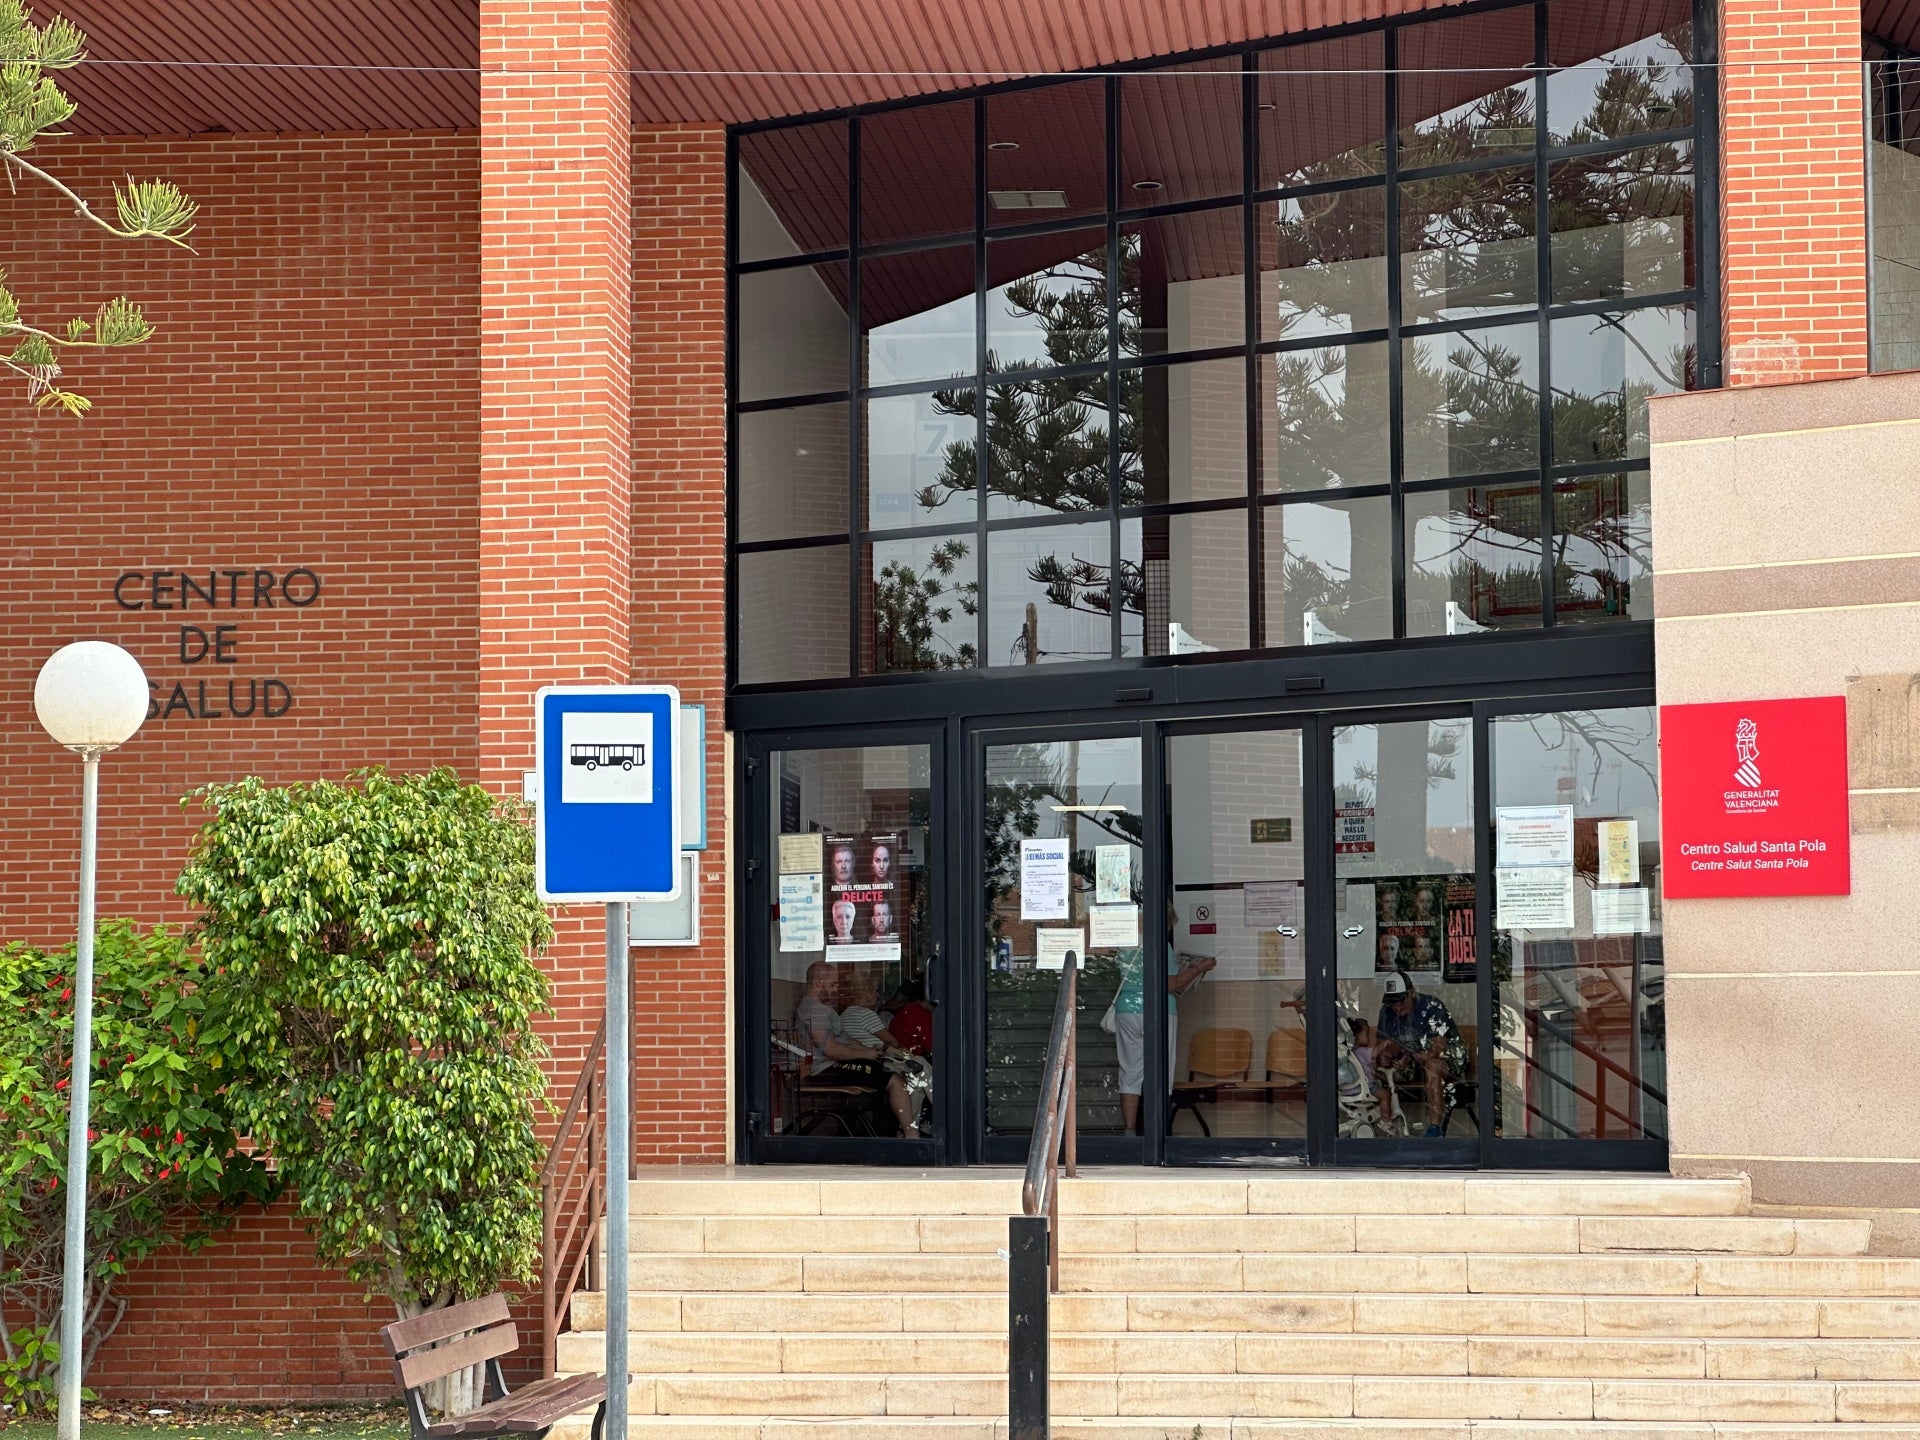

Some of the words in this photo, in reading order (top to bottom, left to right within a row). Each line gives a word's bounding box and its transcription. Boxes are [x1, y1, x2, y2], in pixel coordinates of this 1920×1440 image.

[923, 424, 949, 455] 7
[114, 568, 320, 610] CENTRO
[180, 625, 237, 664] DE
[1724, 790, 1780, 800] GENERALITAT
[1725, 799, 1779, 809] VALENCIANA
[1342, 834, 1367, 842] NECESITE
[1680, 843, 1721, 856] Centro
[1723, 841, 1757, 854] Salud
[1760, 840, 1796, 853] Santa
[1799, 839, 1827, 852] Pola
[1046, 852, 1064, 860] SOCIAL
[1691, 860, 1724, 871] Centre
[1726, 859, 1752, 870] Salut
[1754, 858, 1783, 869] Santa
[1785, 858, 1809, 868] Pola
[841, 890, 884, 903] DELICTE
[1463, 908, 1474, 936] TI
[1449, 936, 1477, 964] DUEL
